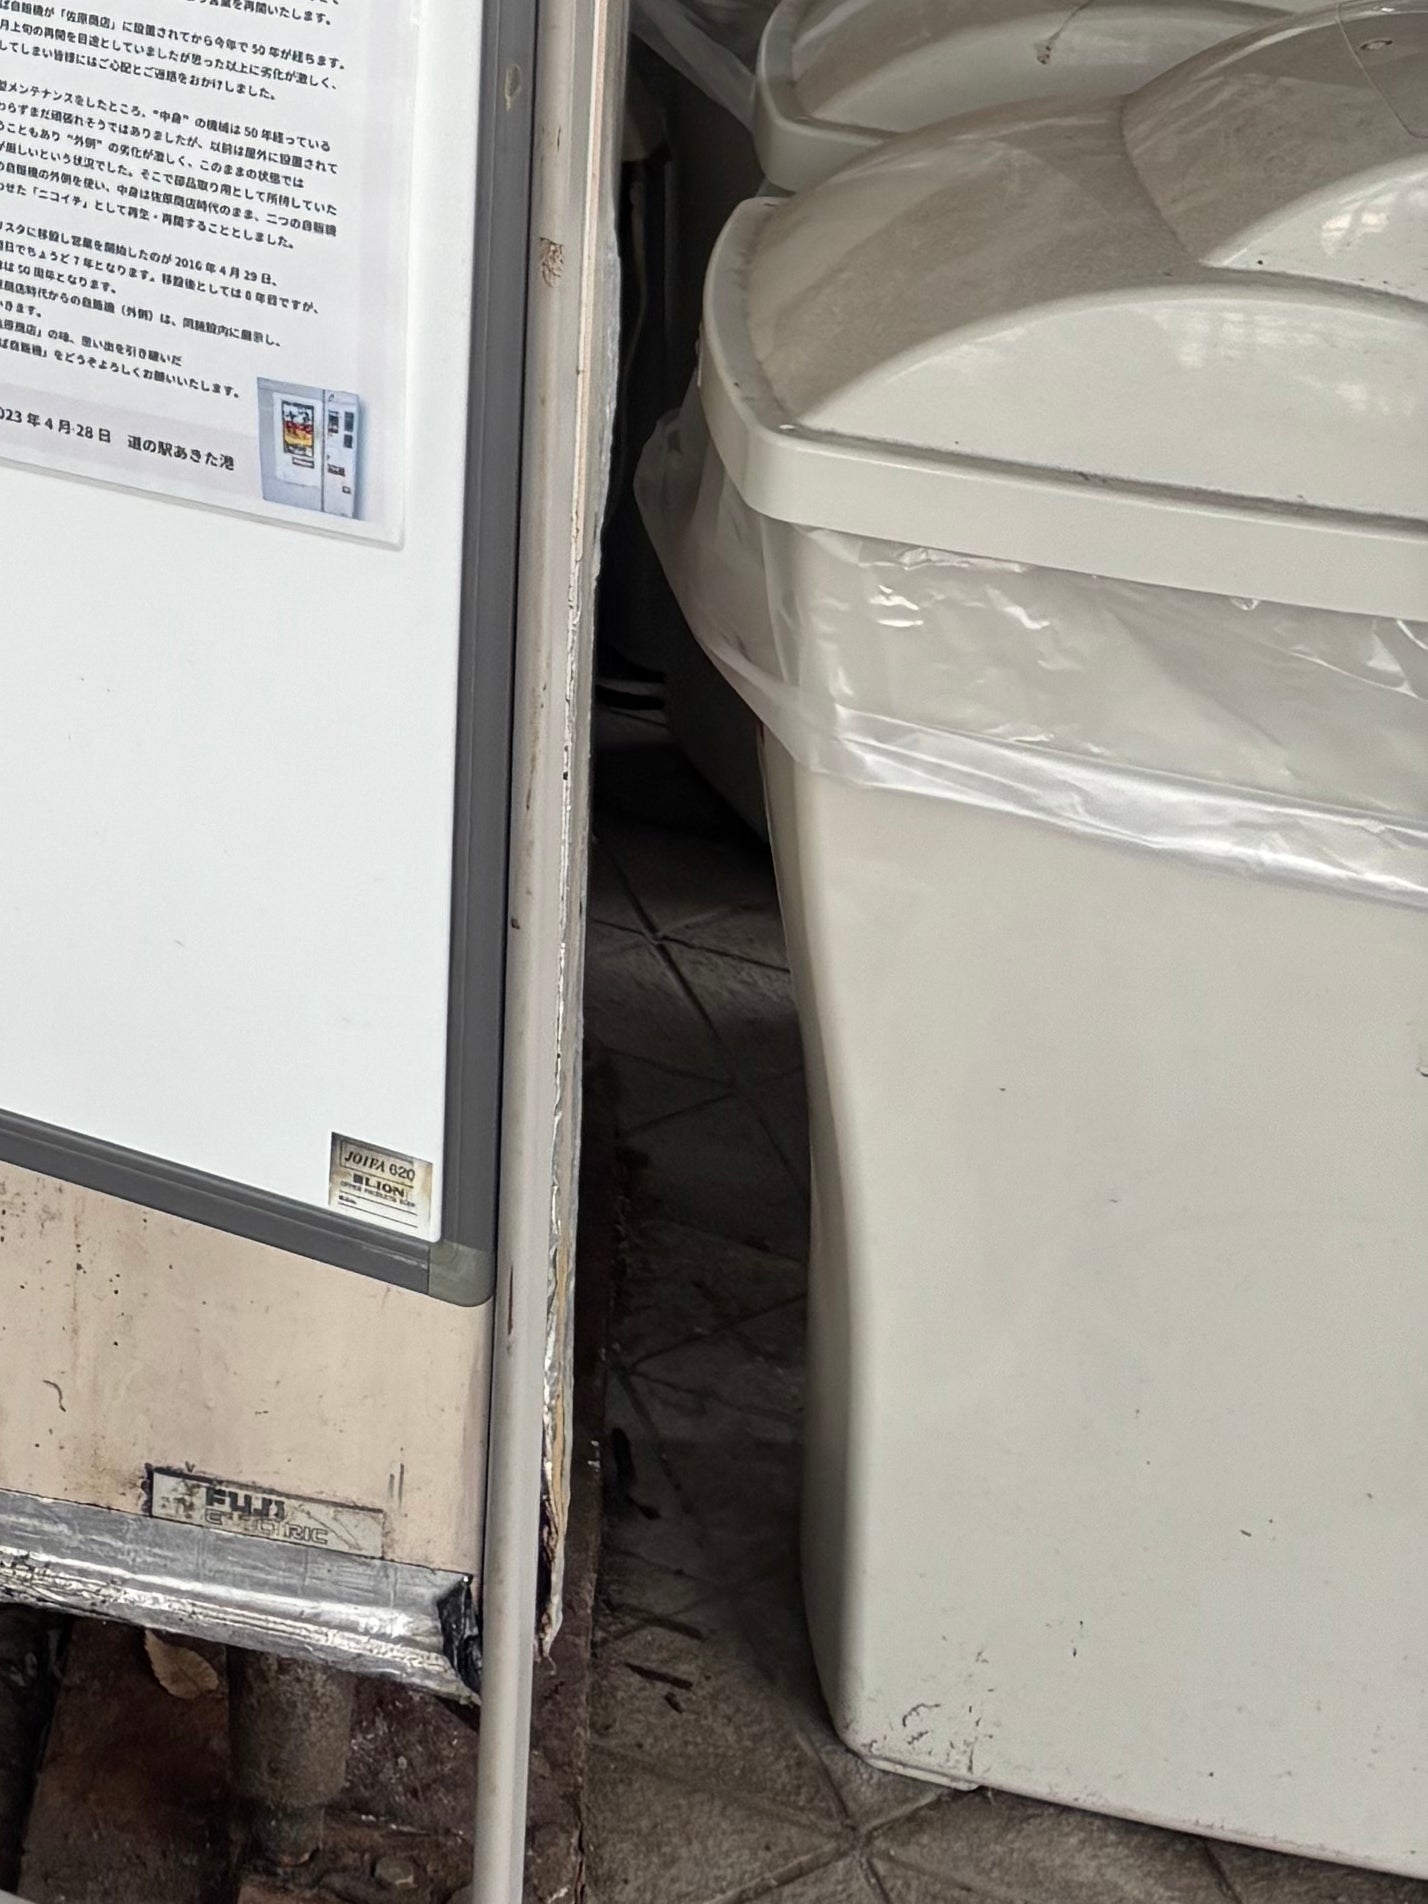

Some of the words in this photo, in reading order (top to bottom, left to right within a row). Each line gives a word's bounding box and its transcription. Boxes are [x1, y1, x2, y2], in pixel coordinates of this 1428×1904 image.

[127, 435, 235, 471] 道の駅あきた港
[388, 1163, 416, 1183] 620
[365, 1177, 406, 1198] LION
[206, 1486, 285, 1520] FUJI
